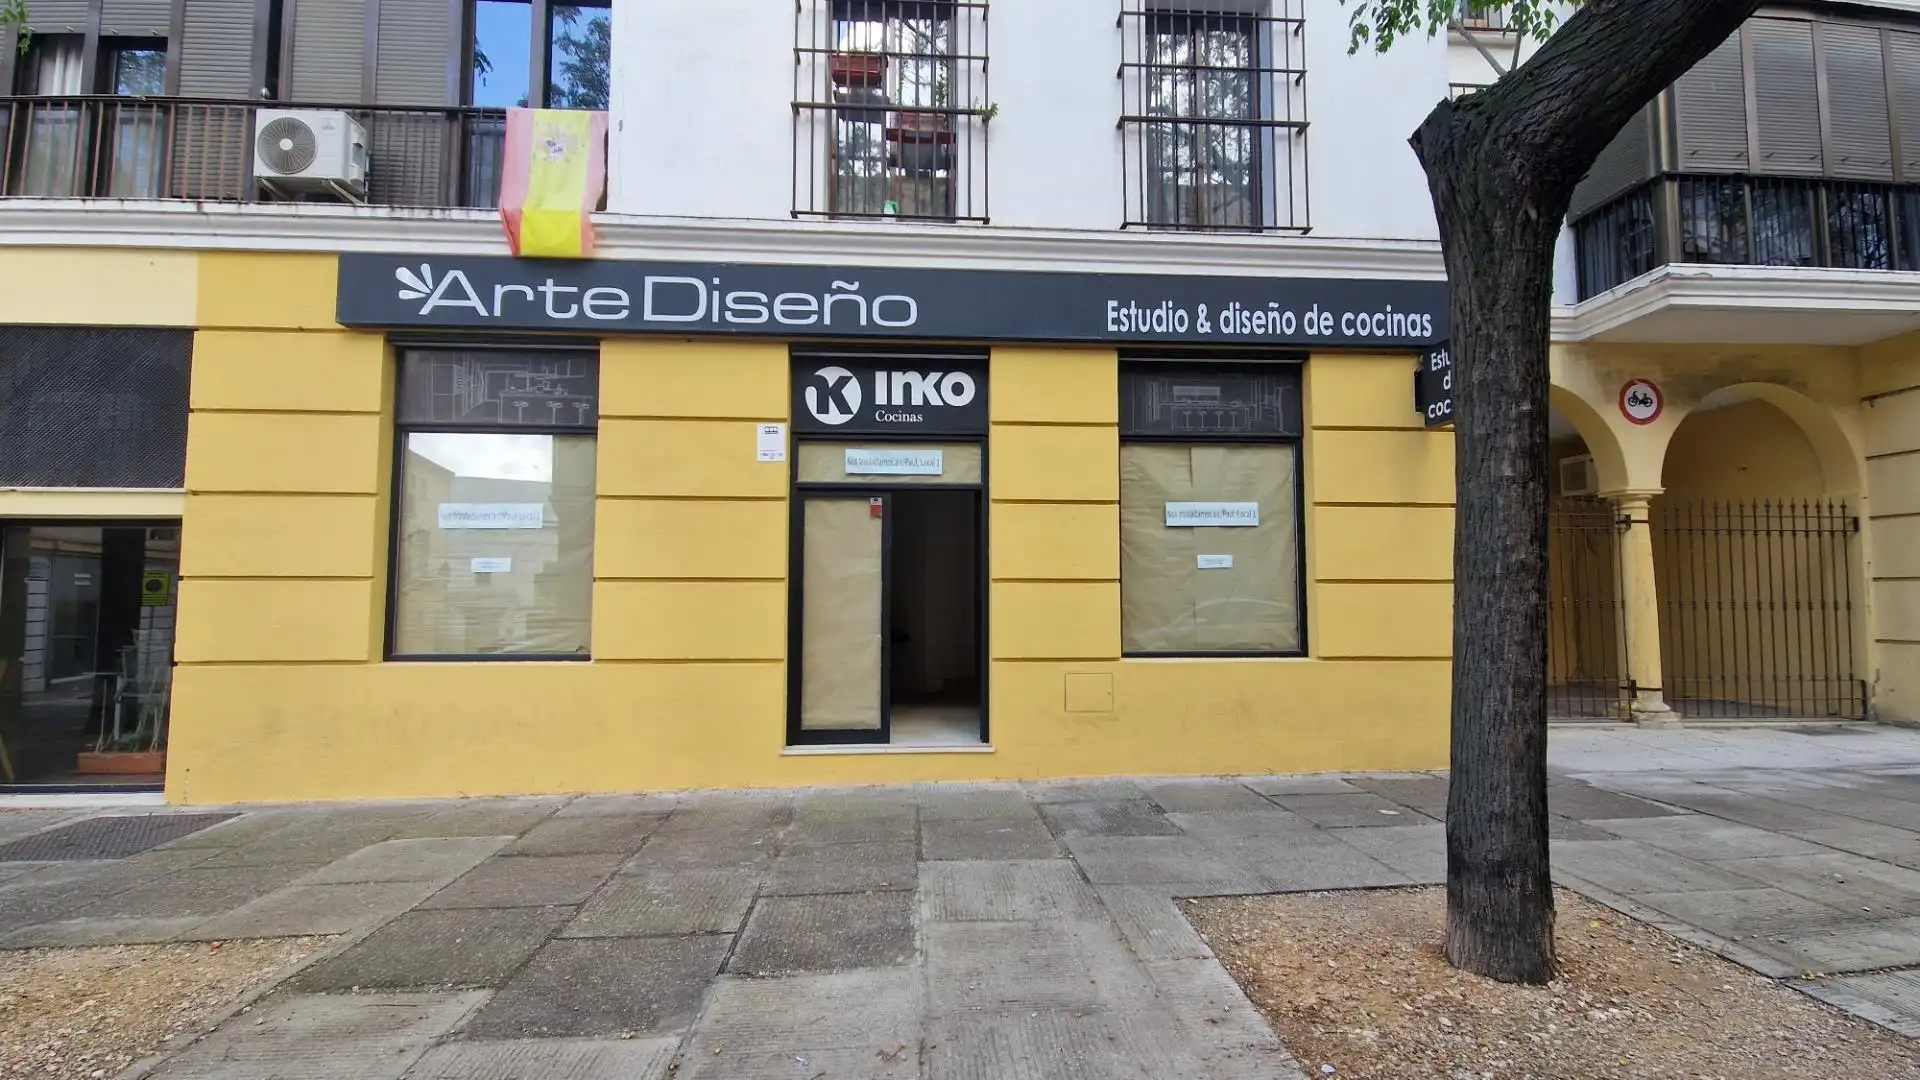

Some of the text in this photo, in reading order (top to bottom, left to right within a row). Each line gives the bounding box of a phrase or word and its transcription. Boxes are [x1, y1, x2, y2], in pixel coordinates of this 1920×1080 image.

[419, 269, 920, 327] Arte Diseño
[1107, 300, 1433, 338] Estudio & diseño de cocinas
[1430, 348, 1451, 372] Estu
[1443, 370, 1452, 391] d
[875, 410, 924, 423] Cocinas
[1428, 399, 1452, 419] coc
